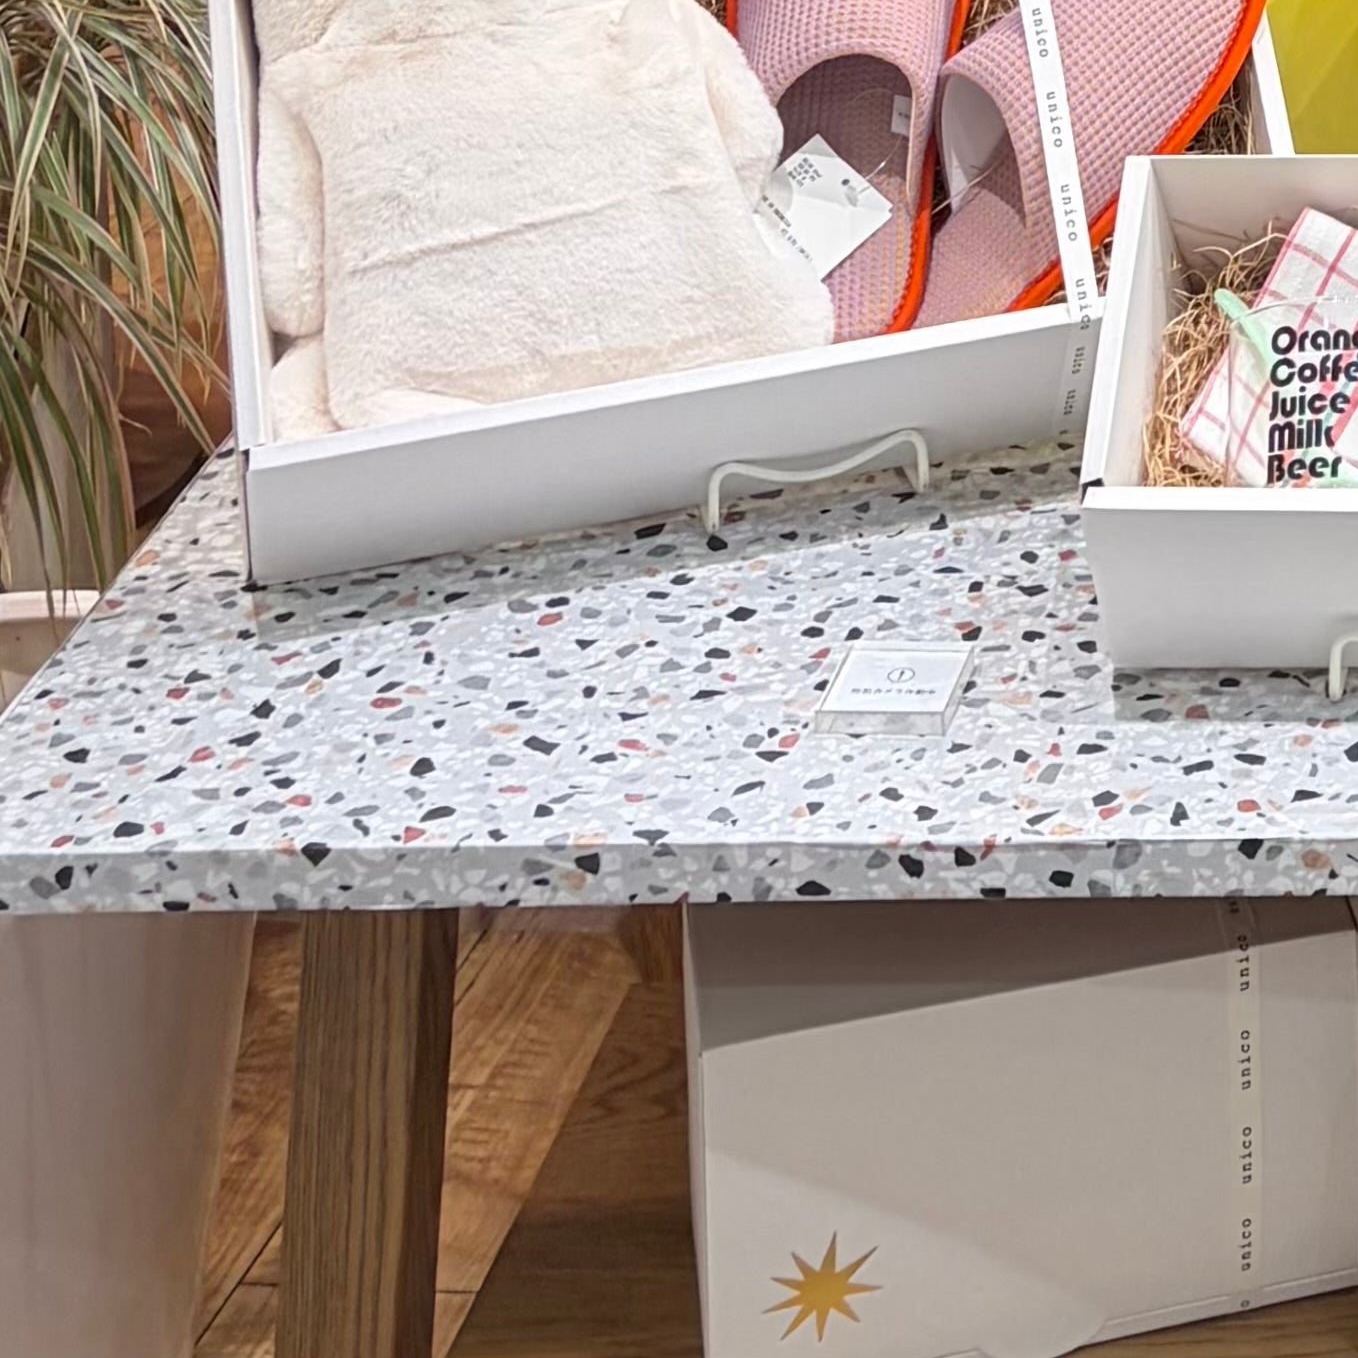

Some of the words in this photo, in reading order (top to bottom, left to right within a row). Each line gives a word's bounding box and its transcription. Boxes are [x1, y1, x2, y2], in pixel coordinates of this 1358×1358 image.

[1031, 6, 1048, 59] unico
[1046, 90, 1063, 149] unico
[1060, 184, 1078, 242] unico
[1269, 385, 1351, 422] Juice
[1268, 418, 1336, 454] Milk
[1267, 454, 1343, 485] Beer
[1237, 934, 1250, 993] unico
[1240, 1029, 1252, 1091] unico
[1242, 1126, 1253, 1185] unico
[1241, 1217, 1253, 1272] unico
